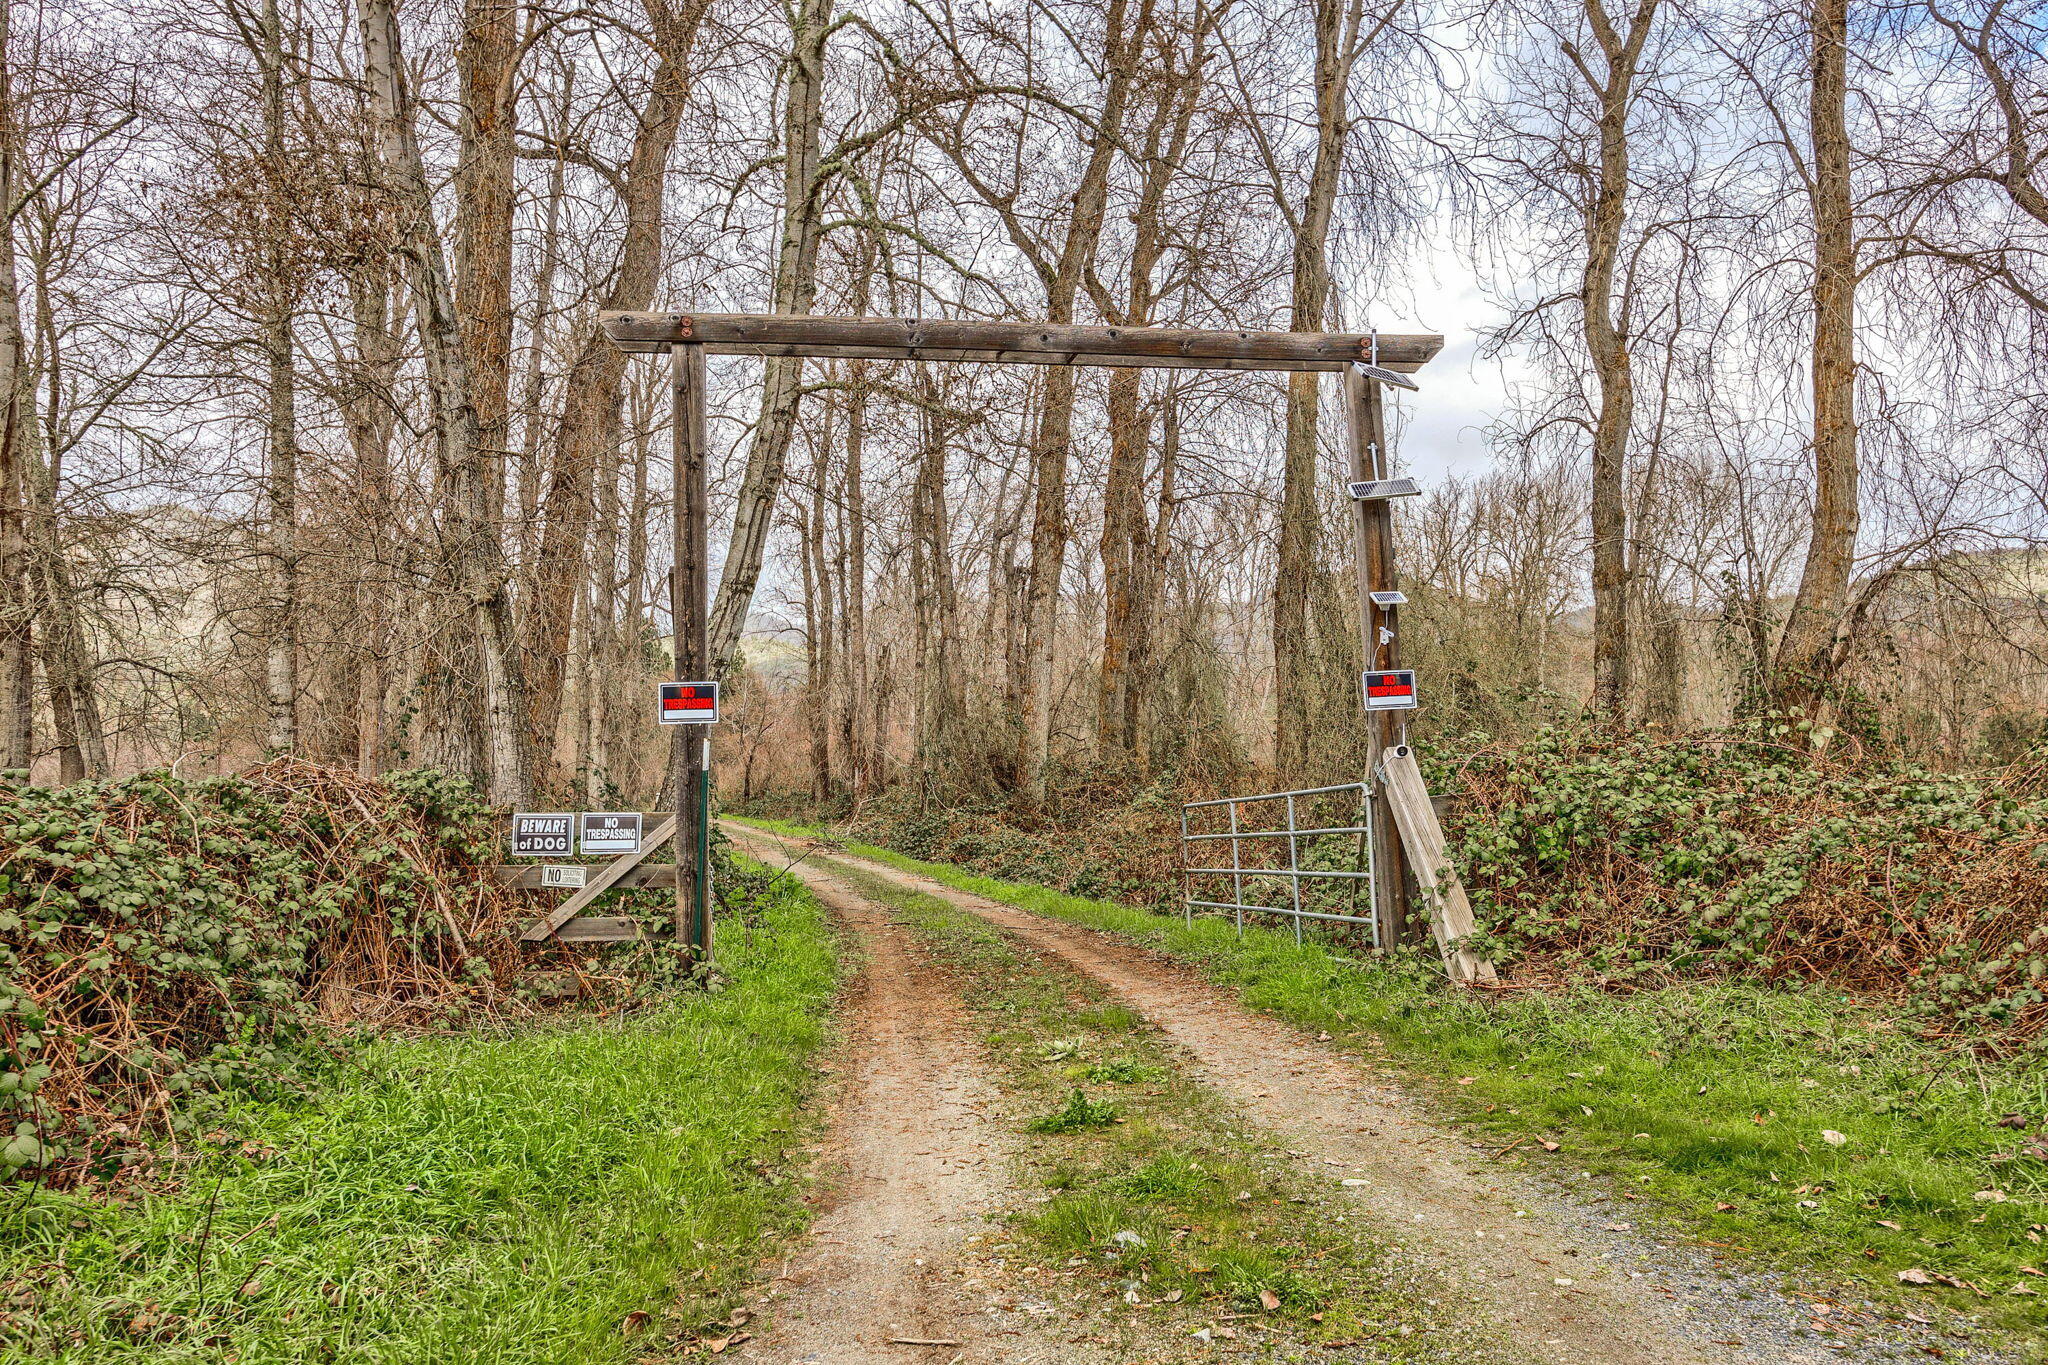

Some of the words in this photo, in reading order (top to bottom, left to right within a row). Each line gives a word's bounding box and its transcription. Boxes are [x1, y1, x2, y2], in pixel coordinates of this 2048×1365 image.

[1383, 675, 1396, 685] NO
[680, 687, 696, 698] NO
[664, 698, 713, 710] TRESPASSING
[520, 819, 567, 833] BEWARE
[604, 817, 619, 828] NO
[586, 829, 636, 840] TRESPASSING
[519, 838, 532, 850] of
[533, 837, 567, 850] DOG
[547, 869, 561, 882] NO
